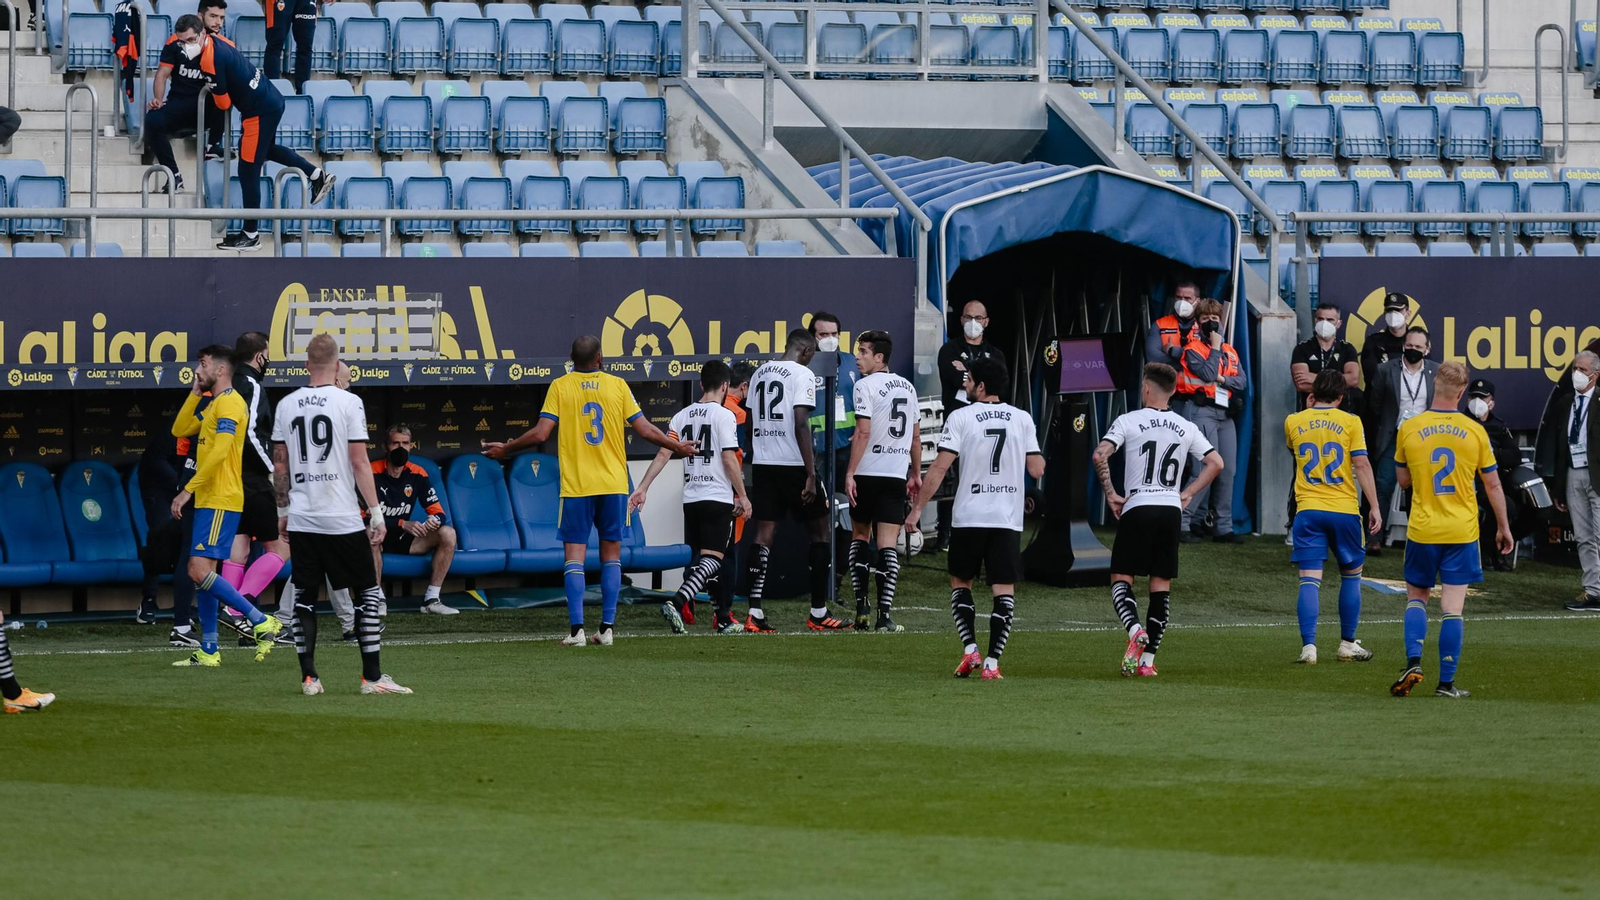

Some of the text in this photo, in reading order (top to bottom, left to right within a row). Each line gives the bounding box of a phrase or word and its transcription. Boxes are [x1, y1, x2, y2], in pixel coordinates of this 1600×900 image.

[961, 14, 998, 25] dafabet
[1012, 15, 1033, 25] dafa
[1112, 16, 1147, 27] dafabet
[1162, 15, 1198, 26] dafabet
[1211, 17, 1247, 27] dafabet
[1260, 18, 1296, 28] dafabet
[1311, 18, 1346, 29] dafabet
[1358, 19, 1393, 30] dafabet
[1406, 20, 1441, 31] dafabet
[1169, 90, 1205, 101] dafabet
[1222, 91, 1257, 102] dafabet
[1328, 94, 1364, 104] dafabet
[1381, 94, 1416, 105] dafabet
[1434, 95, 1469, 105] dafabet
[1484, 95, 1520, 105] dafabet
[1248, 167, 1284, 178] dafabet
[1301, 168, 1336, 179] dafabet
[1355, 168, 1391, 179] dafabet
[1407, 168, 1442, 179] dafabet
[1460, 169, 1496, 180] dafabet
[1513, 169, 1548, 180] dafabet
[0, 312, 188, 364] aLiga
[422, 365, 440, 374] CÁDIZ
[451, 365, 476, 374] FÚTBOL
[611, 362, 635, 371] FÚTBOL
[1084, 360, 1105, 369] VAR
[87, 368, 107, 378] CÁDIZ
[118, 368, 144, 378] FÚTBOL
[362, 367, 389, 379] LaLiga
[524, 366, 550, 377] LaLiga
[24, 372, 53, 383] LaLiga
[581, 381, 599, 391] FALI
[755, 380, 784, 421] 12
[888, 398, 908, 439] 5
[975, 410, 1012, 423] GUEDES
[438, 424, 459, 432] dafabet
[582, 401, 605, 446] 3
[1138, 419, 1186, 438] A. BLANCO
[1298, 419, 1344, 435] A. ESPINO
[1417, 424, 1468, 441] JØNSSON
[289, 414, 333, 464] 19
[681, 424, 714, 466] 14
[984, 428, 1007, 475] 7
[1139, 440, 1180, 487] 16
[1298, 441, 1344, 486] 22
[1430, 447, 1456, 496] 2
